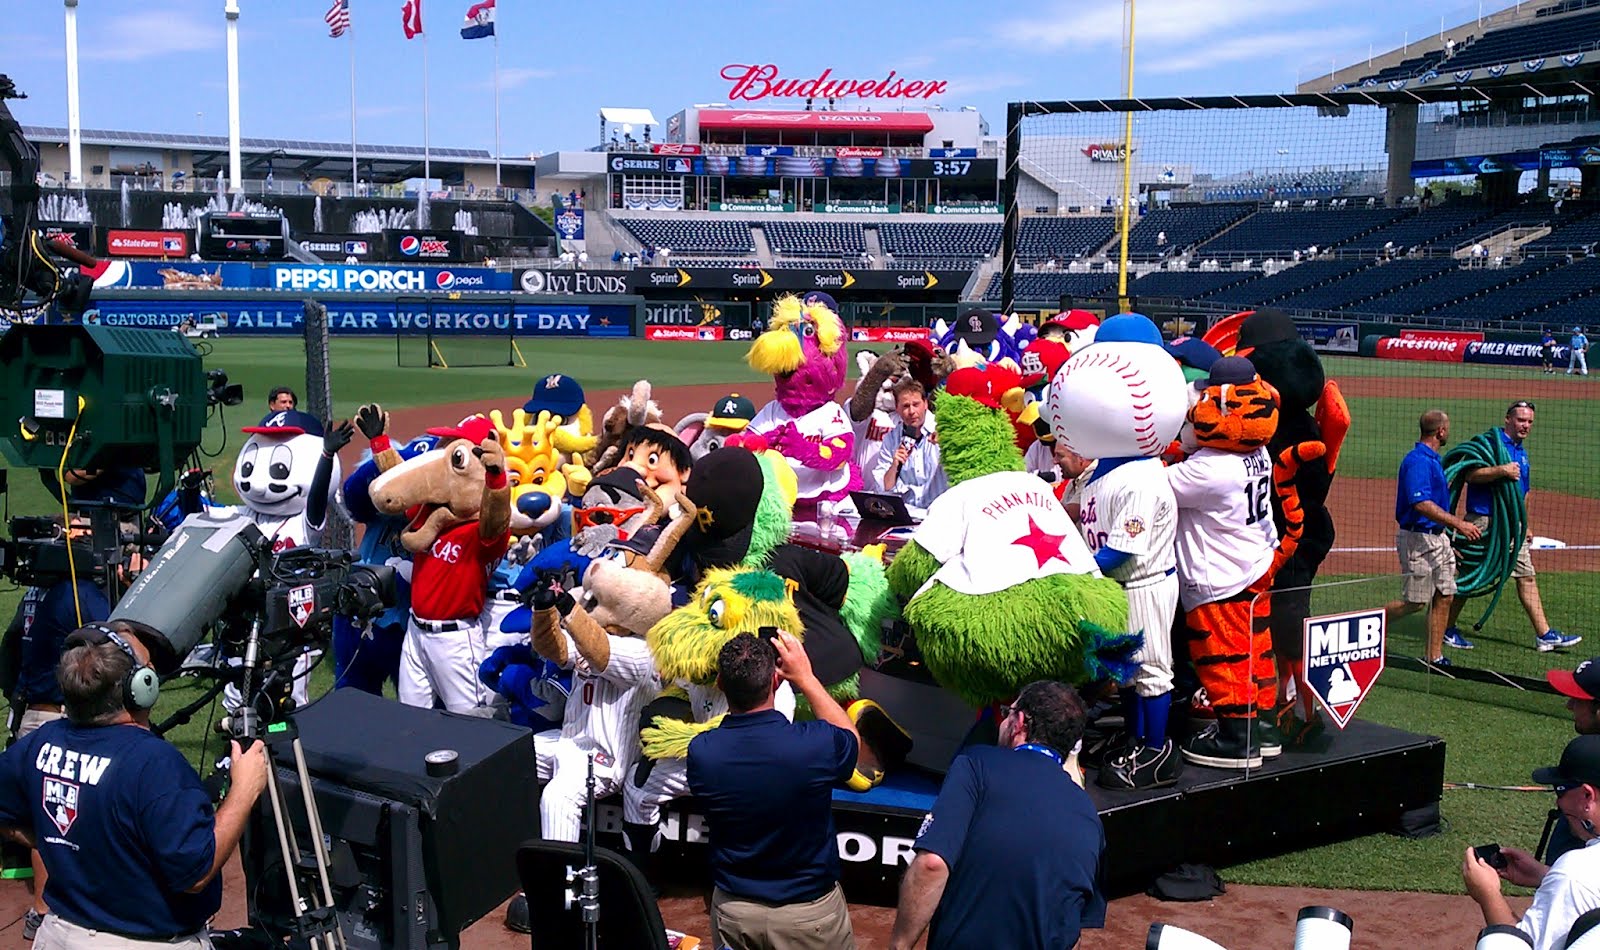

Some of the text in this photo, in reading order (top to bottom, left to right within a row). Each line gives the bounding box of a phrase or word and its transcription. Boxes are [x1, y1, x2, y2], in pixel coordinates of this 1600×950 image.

[720, 64, 948, 101] Budweiser
[1091, 149, 1126, 159] RIVALS
[933, 160, 971, 176] 3:57
[728, 203, 784, 212] Commerce Bank
[833, 204, 889, 213] Commerce Bank
[942, 205, 999, 214] Commerce Bank
[419, 240, 449, 253] MAX
[276, 268, 425, 290] PEPSI PORCH
[455, 275, 484, 286] pepsi
[546, 271, 627, 293] IVY FUNDS
[650, 272, 679, 286] Sprint
[732, 273, 761, 287] Sprint
[815, 274, 843, 287] Sprint
[897, 275, 926, 288] Sprint
[235, 311, 591, 330] ALL TAR WORKOUT DAY
[645, 303, 693, 324] rint
[1480, 343, 1562, 358] MLB NETWOK
[982, 491, 1053, 521] PHANATIC
[1243, 475, 1269, 526] 12
[1081, 496, 1098, 526] ets
[290, 587, 313, 604] MLB
[1310, 616, 1382, 657] MLB
[1309, 647, 1381, 668] NETWORK
[35, 742, 112, 786] CREW
[45, 780, 77, 804] MLB
